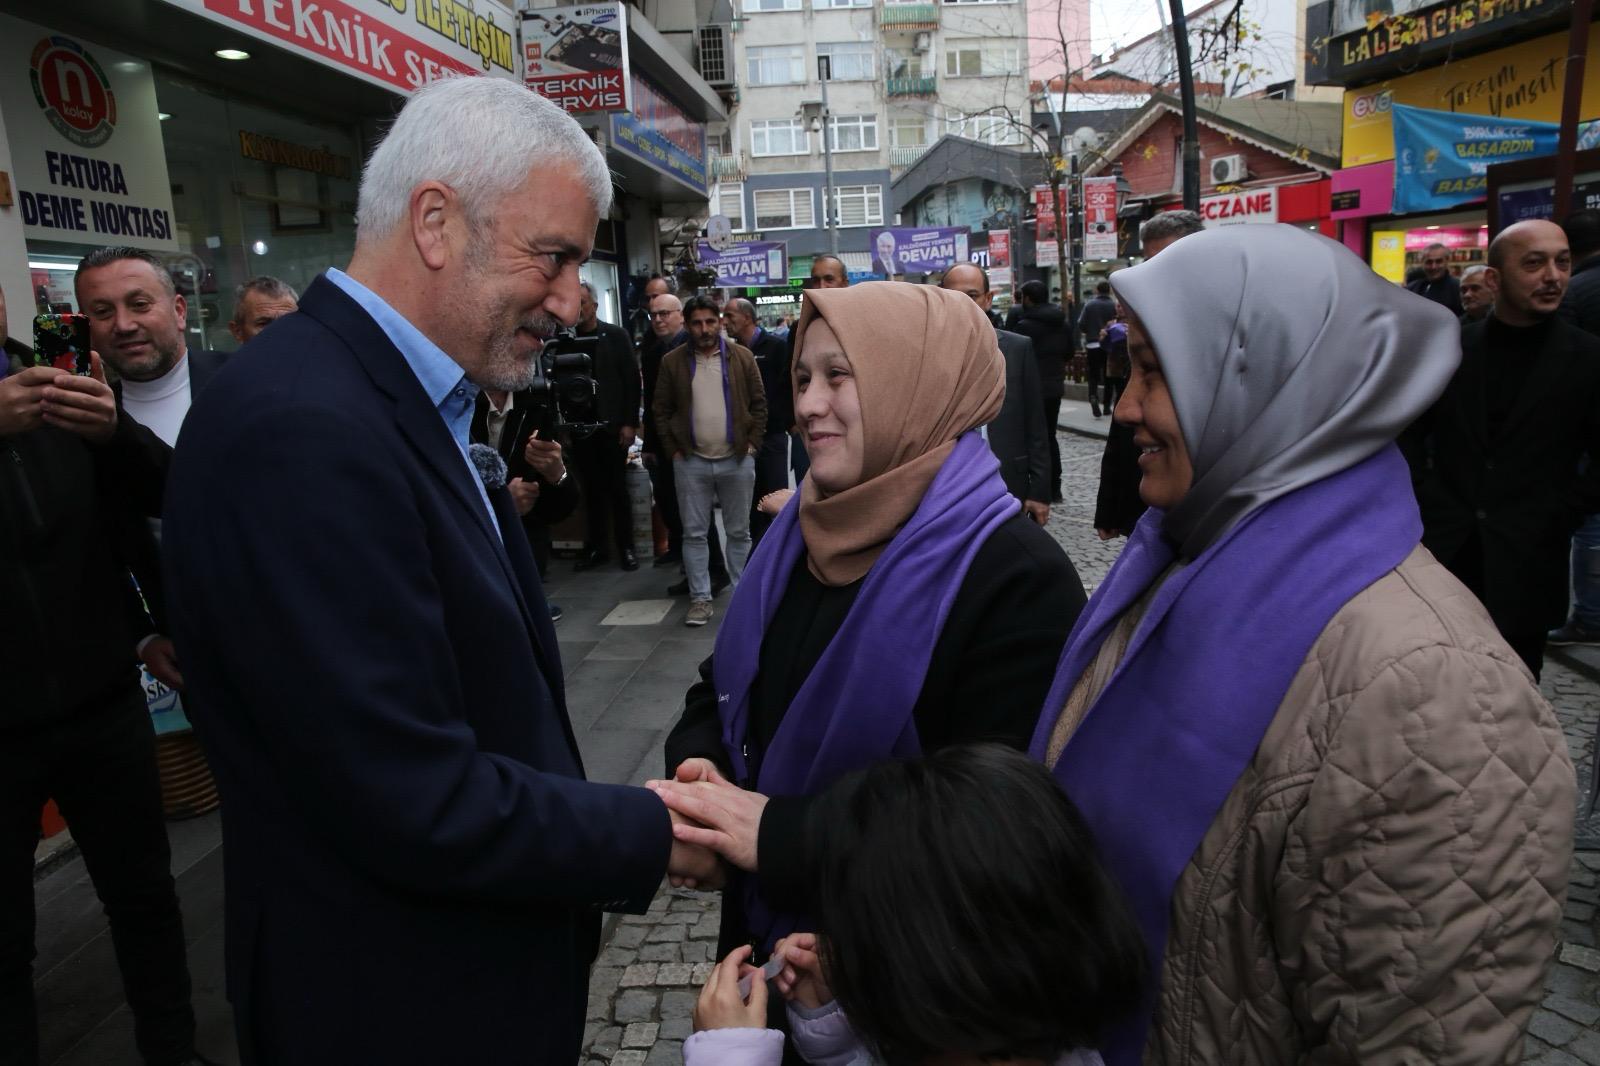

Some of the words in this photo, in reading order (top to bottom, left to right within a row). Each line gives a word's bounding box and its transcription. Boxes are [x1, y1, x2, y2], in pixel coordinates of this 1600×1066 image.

[583, 8, 616, 16] iPhone
[62, 103, 93, 125] kolay
[45, 150, 128, 195] FATURA
[90, 200, 172, 241] NOKTASI
[899, 244, 954, 263] DEVAM
[756, 295, 795, 304] AYDEMİR
